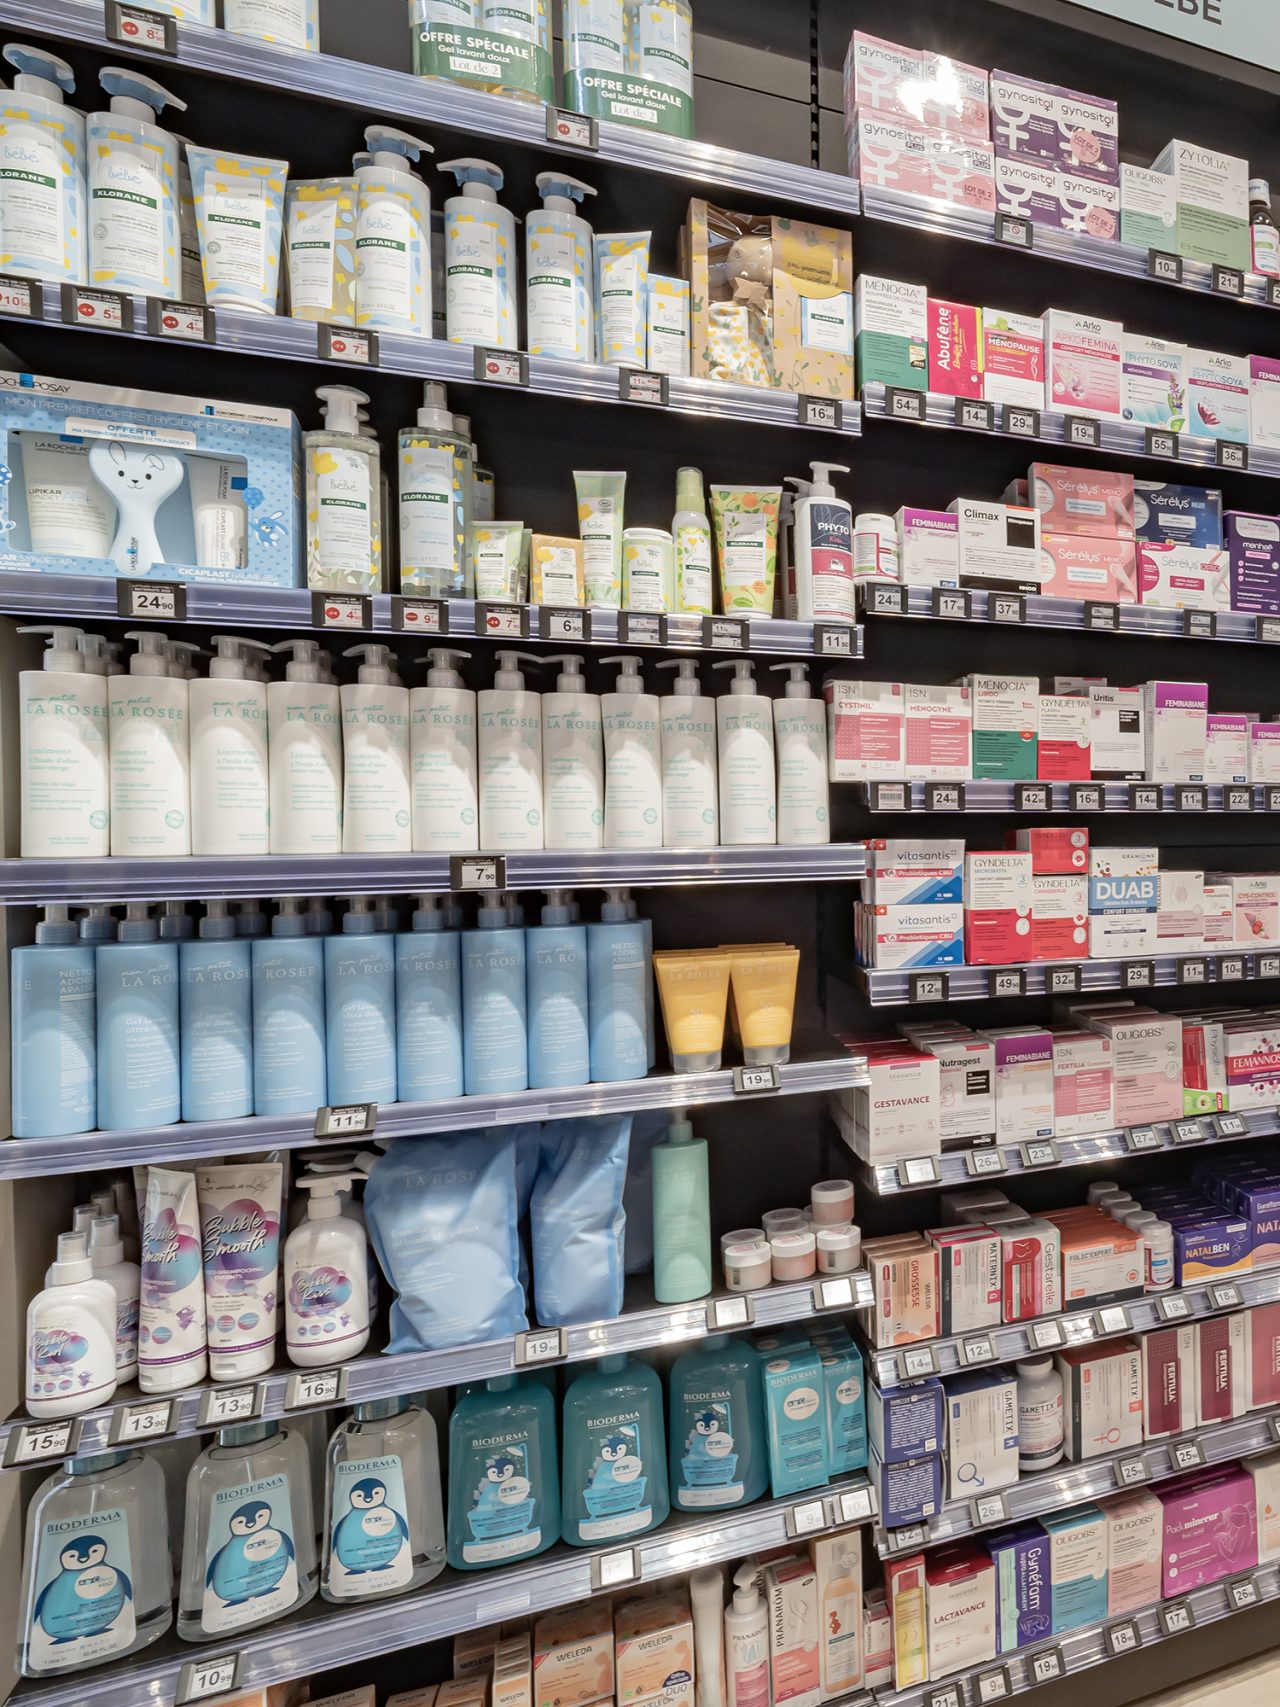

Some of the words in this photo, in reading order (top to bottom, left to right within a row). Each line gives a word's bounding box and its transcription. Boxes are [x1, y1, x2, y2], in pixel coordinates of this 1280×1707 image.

[489, 8, 529, 22] KLORANE
[419, 31, 463, 48] OFFRE
[465, 35, 529, 59] SPÉCIALE
[576, 33, 616, 49] KLORANE
[438, 43, 456, 55] Gel
[456, 46, 484, 60] lavant
[486, 52, 511, 64] doux
[649, 48, 686, 65] KLORANE
[859, 44, 921, 71] gynositol
[583, 76, 625, 92] OFFRE
[627, 81, 683, 108] SPÉCIALE
[998, 86, 1054, 113] gynositol
[600, 90, 618, 101] Gel
[619, 92, 644, 106] lavant
[645, 98, 667, 111] doux
[1061, 101, 1114, 128] gynositol
[863, 121, 925, 145] gynositol
[905, 141, 925, 151] PLUS
[1179, 146, 1227, 172] ZYTOLIA
[0, 169, 47, 184] LORANE
[999, 163, 1056, 190] gynositol
[1125, 166, 1164, 185] OLIGOBS
[97, 189, 149, 204] KLORANE
[1063, 178, 1116, 206] gynositol
[214, 215, 254, 226] KLORANE
[358, 240, 398, 248] KLORANE
[448, 266, 492, 276] KLORANE
[529, 277, 570, 287] KLORANE
[865, 279, 918, 298] MÉNOCIA
[811, 314, 844, 323] KLORANE
[655, 327, 685, 336] KLORANE
[1083, 321, 1101, 332] Arko
[937, 307, 950, 370] Abufène
[988, 336, 1040, 354] MÉNOPAUSE
[1055, 332, 1118, 352] ARKOFEMINA
[1151, 341, 1165, 349] Arko
[1129, 353, 1155, 365] PHYTO
[1158, 357, 1178, 370] SOYA
[1216, 357, 1232, 368] Arko
[1192, 371, 1243, 387] PHYTOSOYA
[107, 424, 157, 436] OFFERTE
[28, 488, 62, 496] LIPIKAR
[1056, 479, 1099, 494] Sérélys
[325, 499, 362, 508] KLORANE
[401, 492, 442, 502] KLORANE
[964, 507, 999, 522] Climax
[817, 520, 850, 536] PHYTO
[912, 518, 957, 531] FEMINABIANE
[1058, 548, 1100, 562] Sérélys
[1161, 556, 1199, 570] Sérélys
[178, 568, 232, 578] CICAPLAST
[837, 685, 856, 695] ISN
[977, 679, 1026, 691] MÉNOCIA
[909, 688, 927, 698] ISN
[1093, 693, 1114, 702] Uritis
[838, 701, 873, 710] CYSTINIL
[910, 705, 952, 713] MENOGYNE
[1041, 698, 1087, 709] GYNDELTA
[1165, 700, 1206, 709] FEMINABIANE
[1210, 723, 1246, 732] FEMINABIANE
[897, 852, 951, 861] vitasantis
[974, 858, 1023, 868] GYNDELTA
[1033, 879, 1081, 889] GYNDELTA
[1096, 882, 1154, 900] DUAB
[1238, 892, 1276, 900] CYS-CONTROL
[898, 914, 951, 925] vitasantis
[1116, 1028, 1161, 1041] OLIGOBS
[1006, 1052, 1051, 1063] FEMINABIANE
[1057, 1048, 1072, 1057] ISN
[940, 1057, 981, 1068] Nutragest
[1057, 1062, 1085, 1071] FERTILIA
[874, 1096, 930, 1109] GESTAVANCE
[205, 1211, 265, 1240] Bubble
[203, 1229, 267, 1262] Smooth
[1185, 1242, 1230, 1259] NATALBEN
[989, 1242, 997, 1287] MATERNIX
[1045, 1243, 1053, 1306] Gestarelle
[911, 1260, 920, 1308] GROSSESSE
[770, 1370, 818, 1386] BIODERMA
[1130, 1357, 1138, 1398] GAMETIX
[1168, 1362, 1176, 1402] FERTILIA
[683, 1390, 732, 1400] BIODERMA
[1004, 1390, 1014, 1432] GAMETIX
[1020, 1403, 1055, 1414] GAMETIX
[586, 1411, 641, 1428] BIODERMA
[472, 1430, 529, 1447] BIODERMA
[338, 1457, 398, 1473] BIODERMA
[215, 1476, 284, 1502] BIODERMA
[46, 1511, 122, 1535] BIODERMA
[1113, 1515, 1154, 1533] OLIGOBS
[1166, 1522, 1183, 1535] Pack
[1184, 1512, 1220, 1529] minceur
[1055, 1529, 1095, 1546] OLIGOBS
[1028, 1547, 1042, 1610] Gynéfam
[774, 1585, 785, 1648] PRANARÔM
[934, 1600, 986, 1625] LACTAVANCE
[638, 1634, 673, 1651] WELEDA
[556, 1646, 592, 1662] WELEDA
[666, 1683, 688, 1697] DUO
